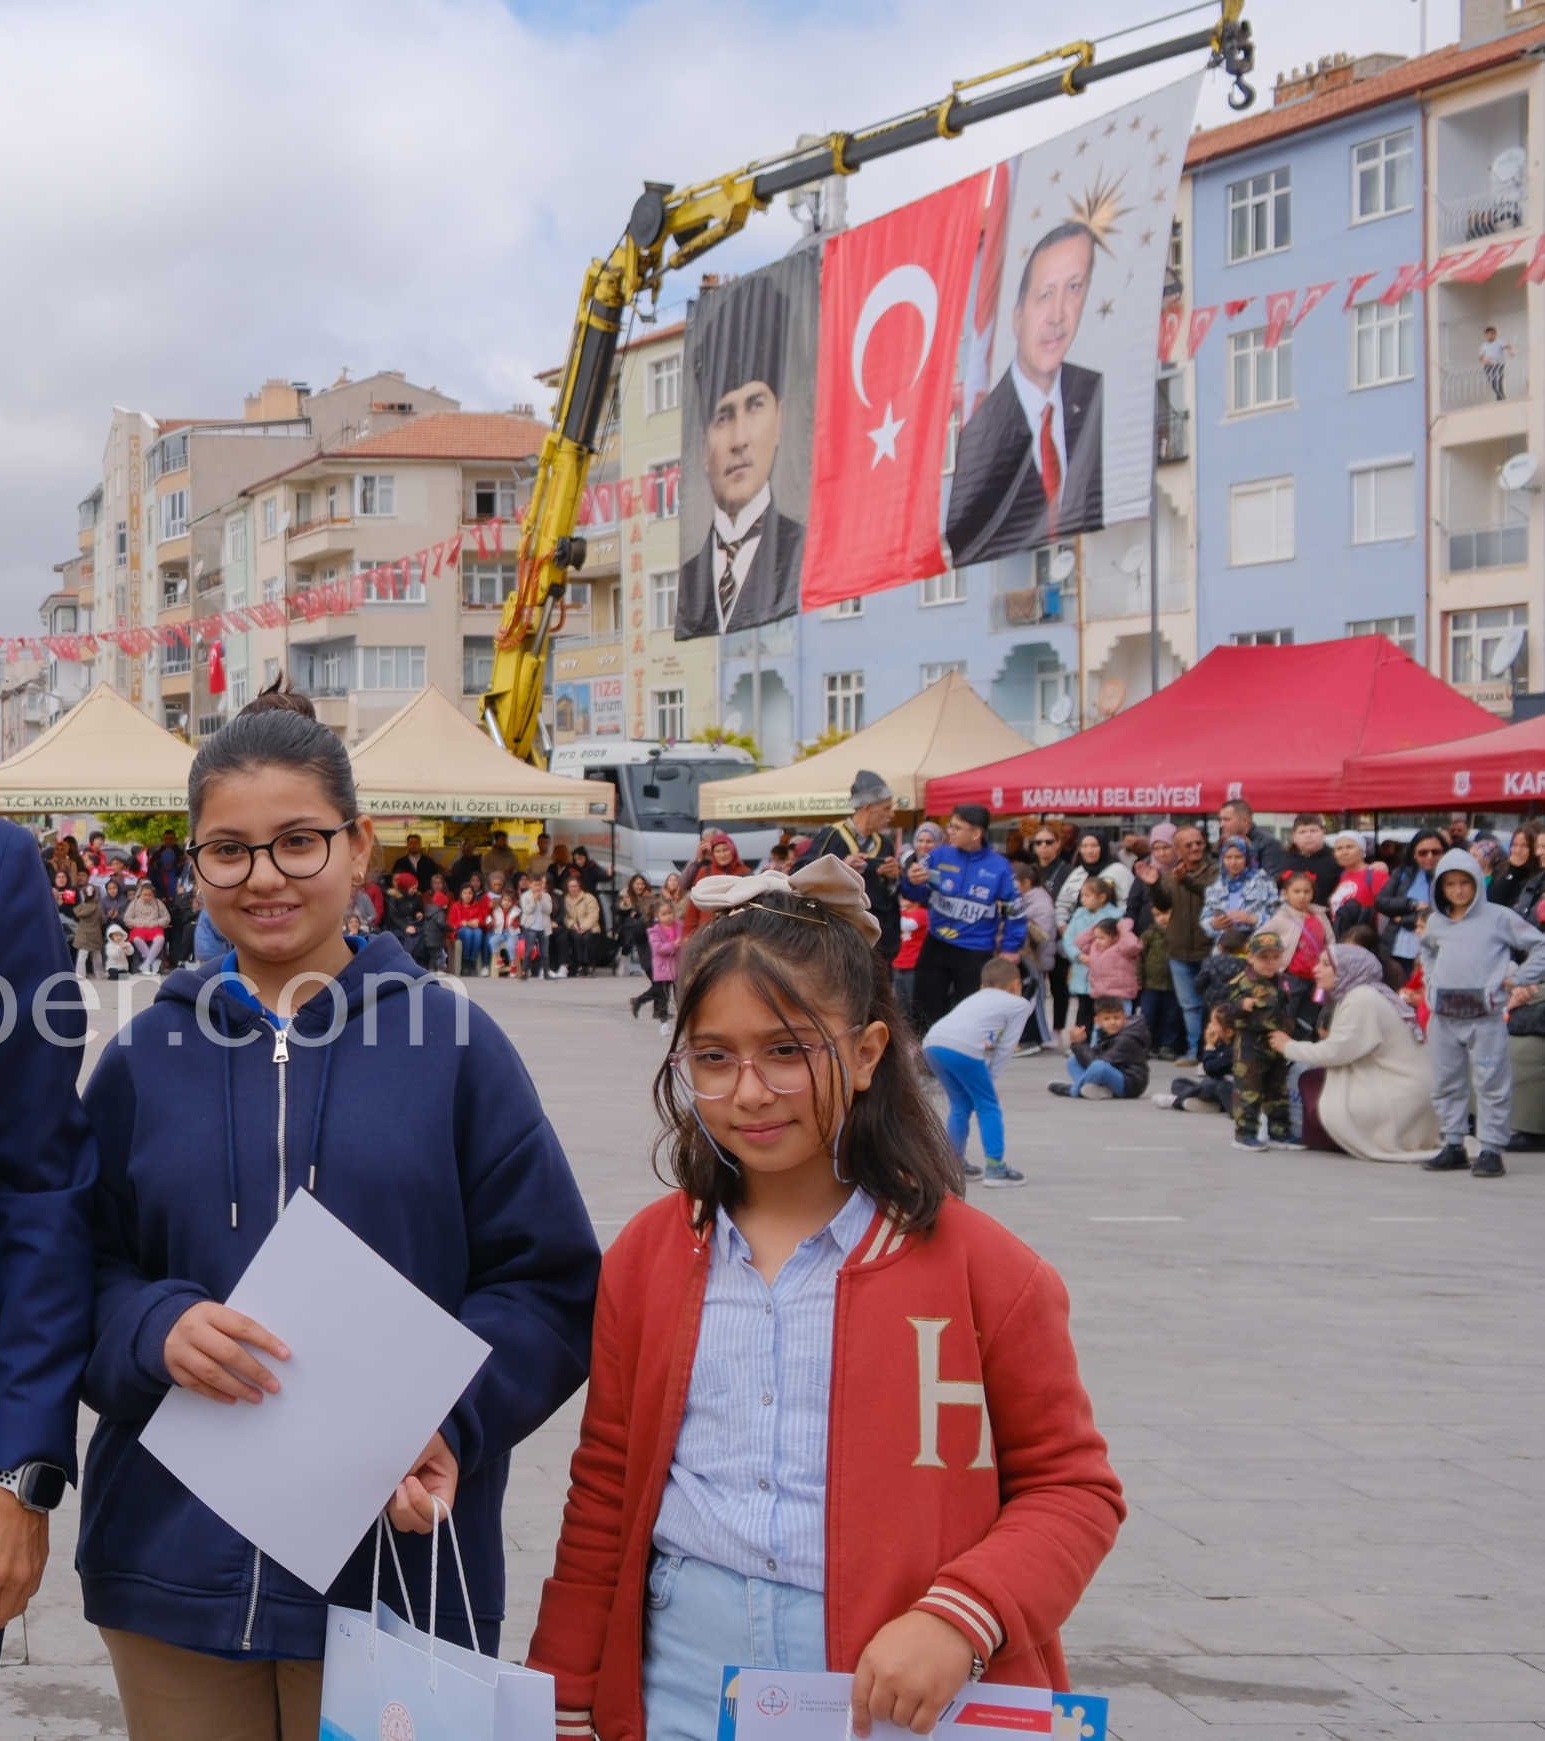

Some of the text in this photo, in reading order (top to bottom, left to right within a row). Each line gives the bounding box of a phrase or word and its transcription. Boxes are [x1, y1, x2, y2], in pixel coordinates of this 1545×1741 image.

[33, 796, 110, 807] KARAMAN
[115, 794, 127, 807] İL
[129, 793, 165, 807] ÖZEL
[1022, 783, 1202, 808] KARAMAN BELEDİYESİ
[370, 799, 447, 811] KARAMAN
[451, 798, 463, 812] İL
[466, 798, 503, 812] ÖZEL
[505, 799, 562, 814] İDARESİ
[745, 800, 796, 813] KARAMAN
[905, 1316, 995, 1470] H
